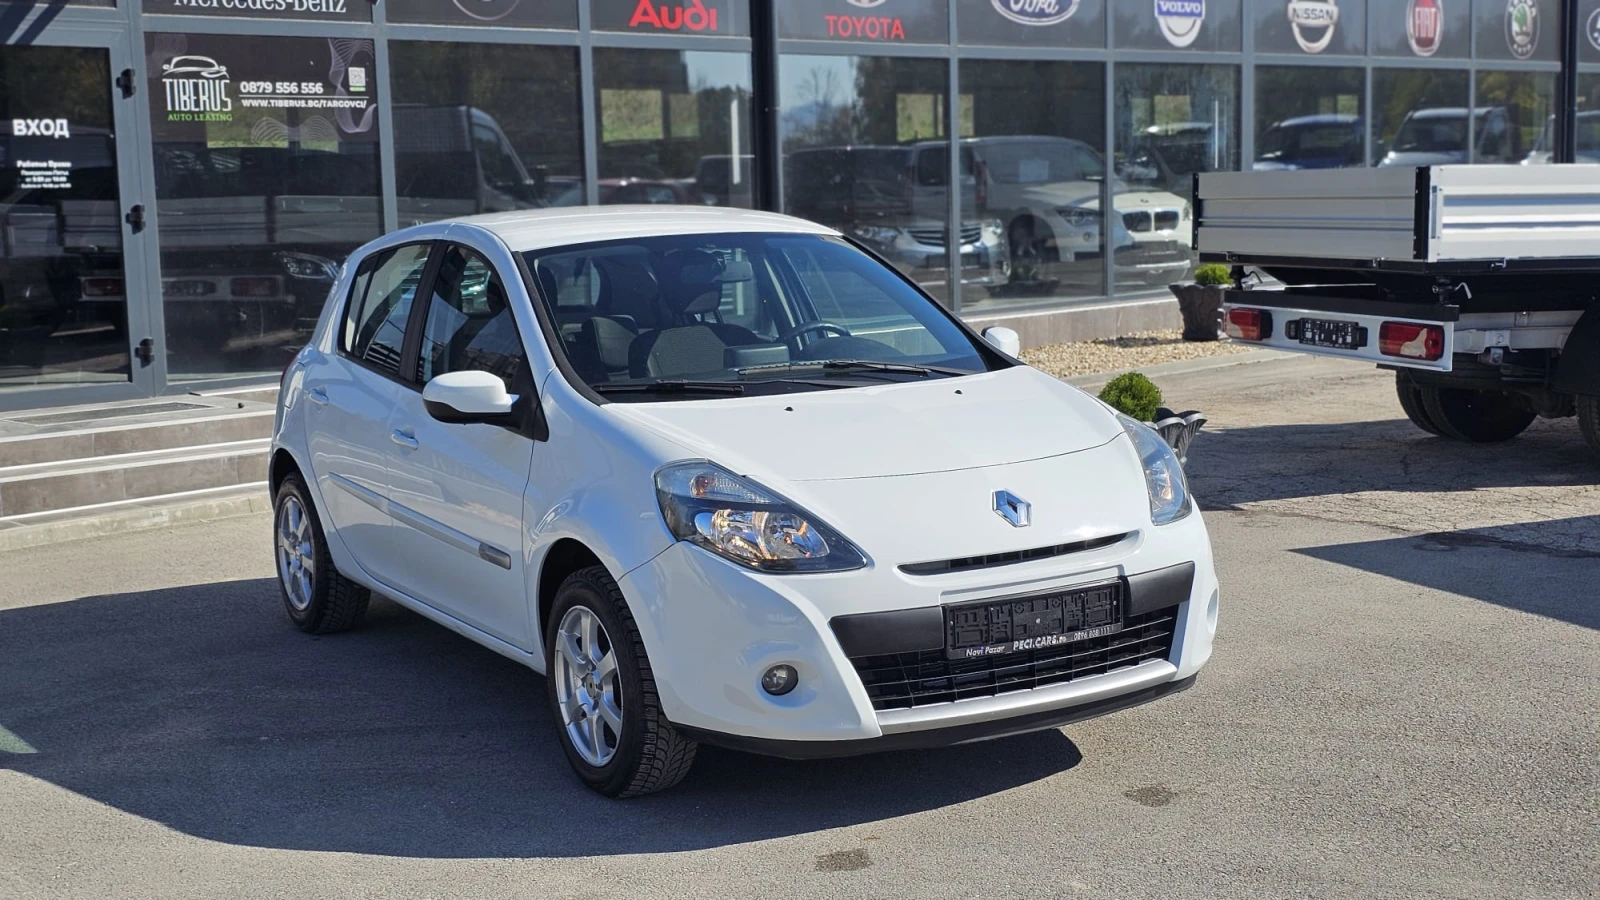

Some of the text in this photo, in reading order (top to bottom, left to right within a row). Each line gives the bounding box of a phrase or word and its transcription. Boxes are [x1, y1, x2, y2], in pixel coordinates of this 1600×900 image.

[174, 0, 347, 13] ercedes-Benz
[1159, 1, 1201, 13] VOLVO
[629, 0, 718, 30] Audi
[1292, 7, 1334, 21] NISSAN
[825, 15, 905, 39] TOYOTA
[1415, 7, 1437, 38] FIAT
[240, 81, 324, 95] 0879 556 556
[162, 79, 233, 112] TIBERUS
[168, 113, 233, 122] AUTO LEASING
[12, 118, 70, 139] ВХОД
[966, 647, 984, 657] Novi
[985, 646, 1005, 656] Pazar
